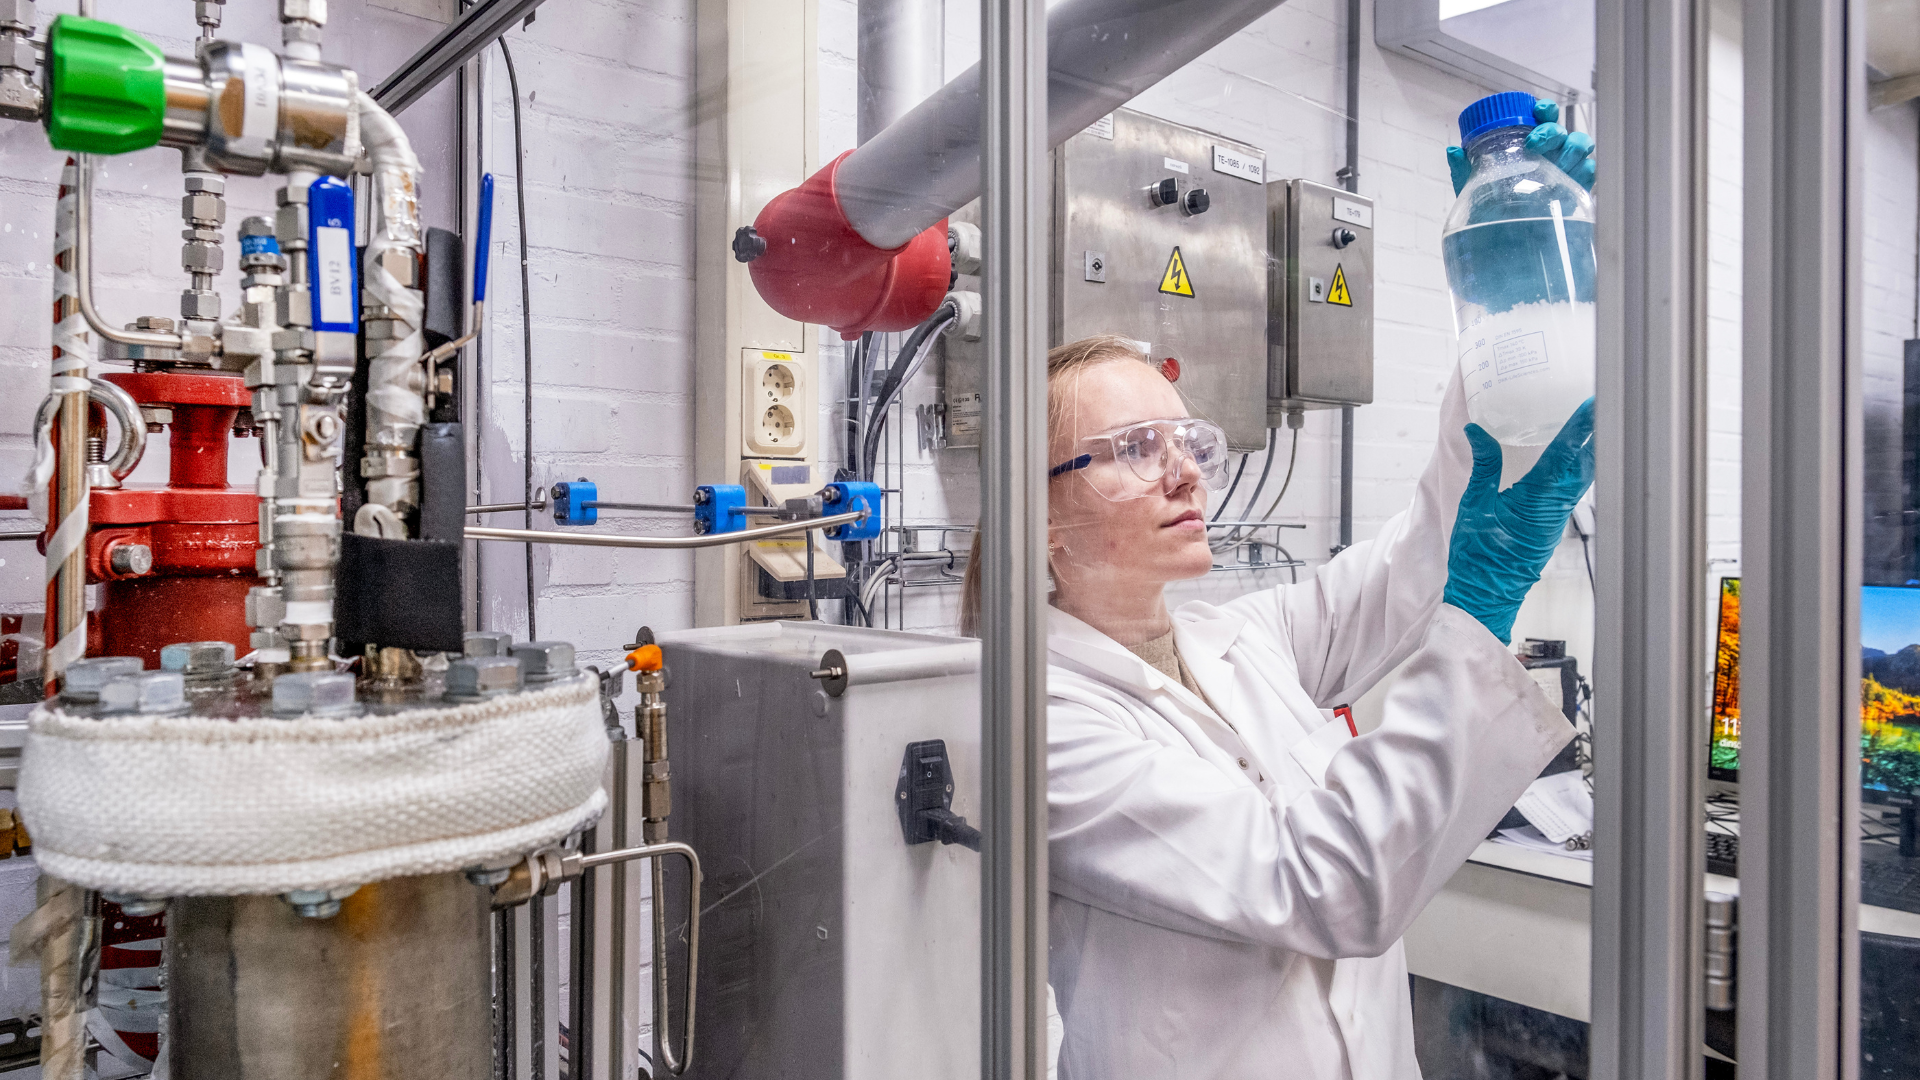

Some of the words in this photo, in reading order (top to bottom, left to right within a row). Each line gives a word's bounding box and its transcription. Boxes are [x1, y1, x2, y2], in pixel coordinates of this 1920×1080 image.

[1218, 154, 1240, 169] TE-1085
[328, 260, 342, 296] BV12
[1474, 338, 1486, 350] 300
[1478, 360, 1490, 372] 200
[1482, 379, 1493, 391] 100
